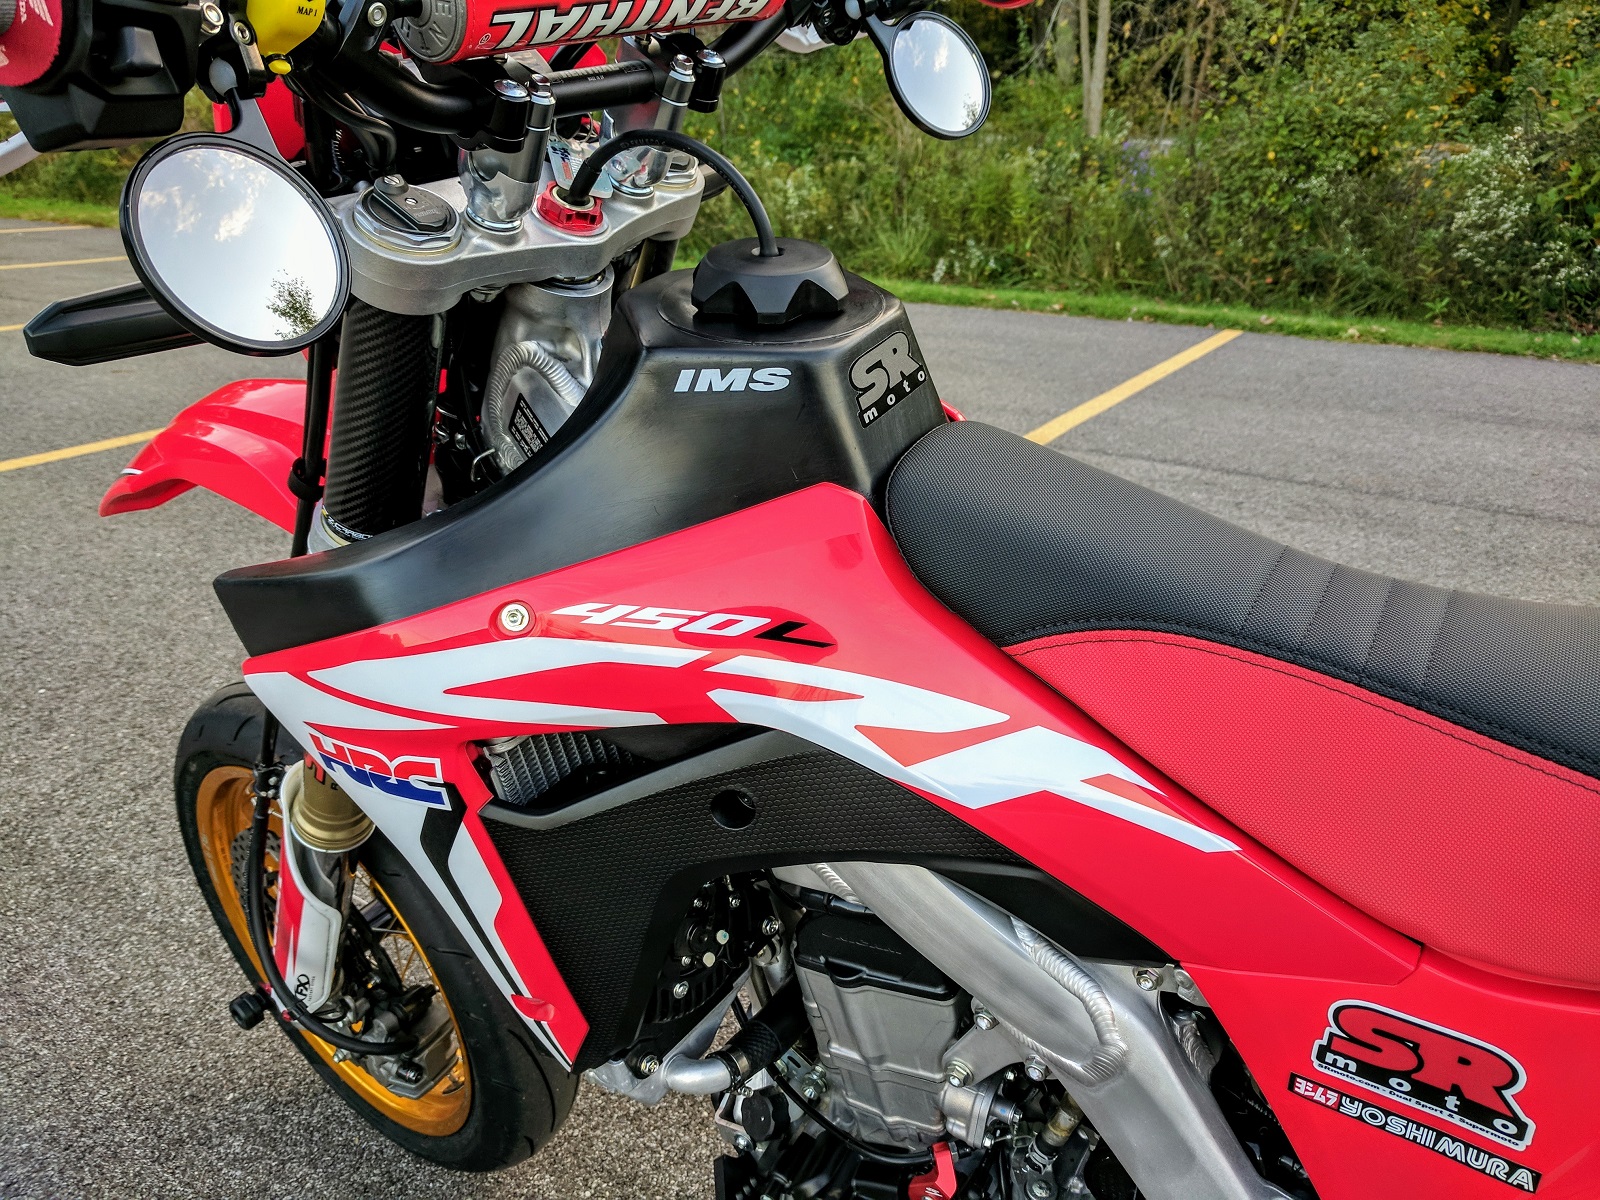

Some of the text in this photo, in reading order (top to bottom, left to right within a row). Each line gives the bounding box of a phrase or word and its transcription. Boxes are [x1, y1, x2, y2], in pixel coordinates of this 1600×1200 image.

[297, 6, 313, 15] MAP
[490, 0, 767, 49] RENTHAL
[674, 367, 792, 393] IMS
[851, 332, 921, 411] SR
[863, 370, 926, 424] moto
[1330, 1007, 1515, 1119] SR
[1324, 1051, 1518, 1136] moto
[1388, 1089, 1412, 1103] Dual
[1415, 1100, 1444, 1116] Sport
[1458, 1116, 1520, 1147] Supermoto
[1293, 1078, 1534, 1192] ヨシムラ YOSHIMURA
